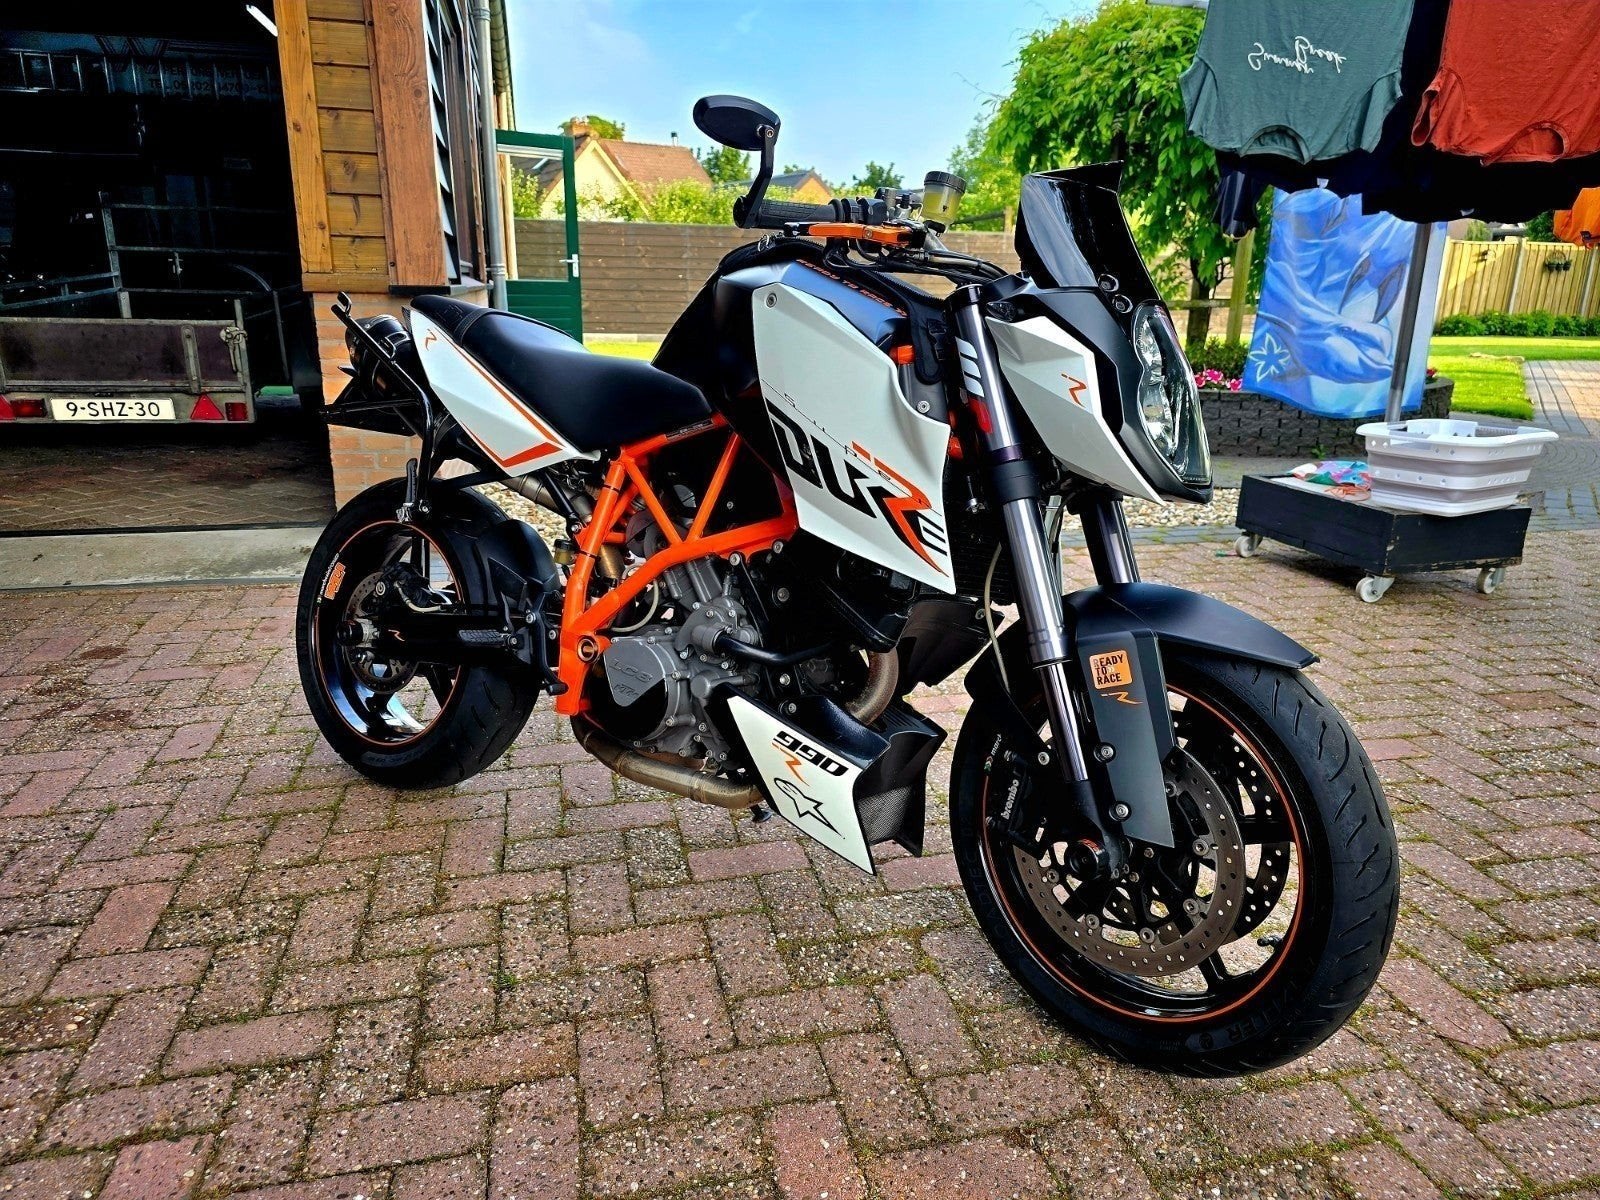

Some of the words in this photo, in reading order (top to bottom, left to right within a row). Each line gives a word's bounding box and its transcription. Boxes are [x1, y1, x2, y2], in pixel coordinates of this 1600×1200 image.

[66, 402, 160, 417] 9-SHZ-30
[1093, 654, 1123, 668] READY
[1095, 666, 1107, 676] TO
[1097, 672, 1122, 685] RACE
[772, 730, 849, 777] 990
[1001, 779, 1019, 820] brembo
